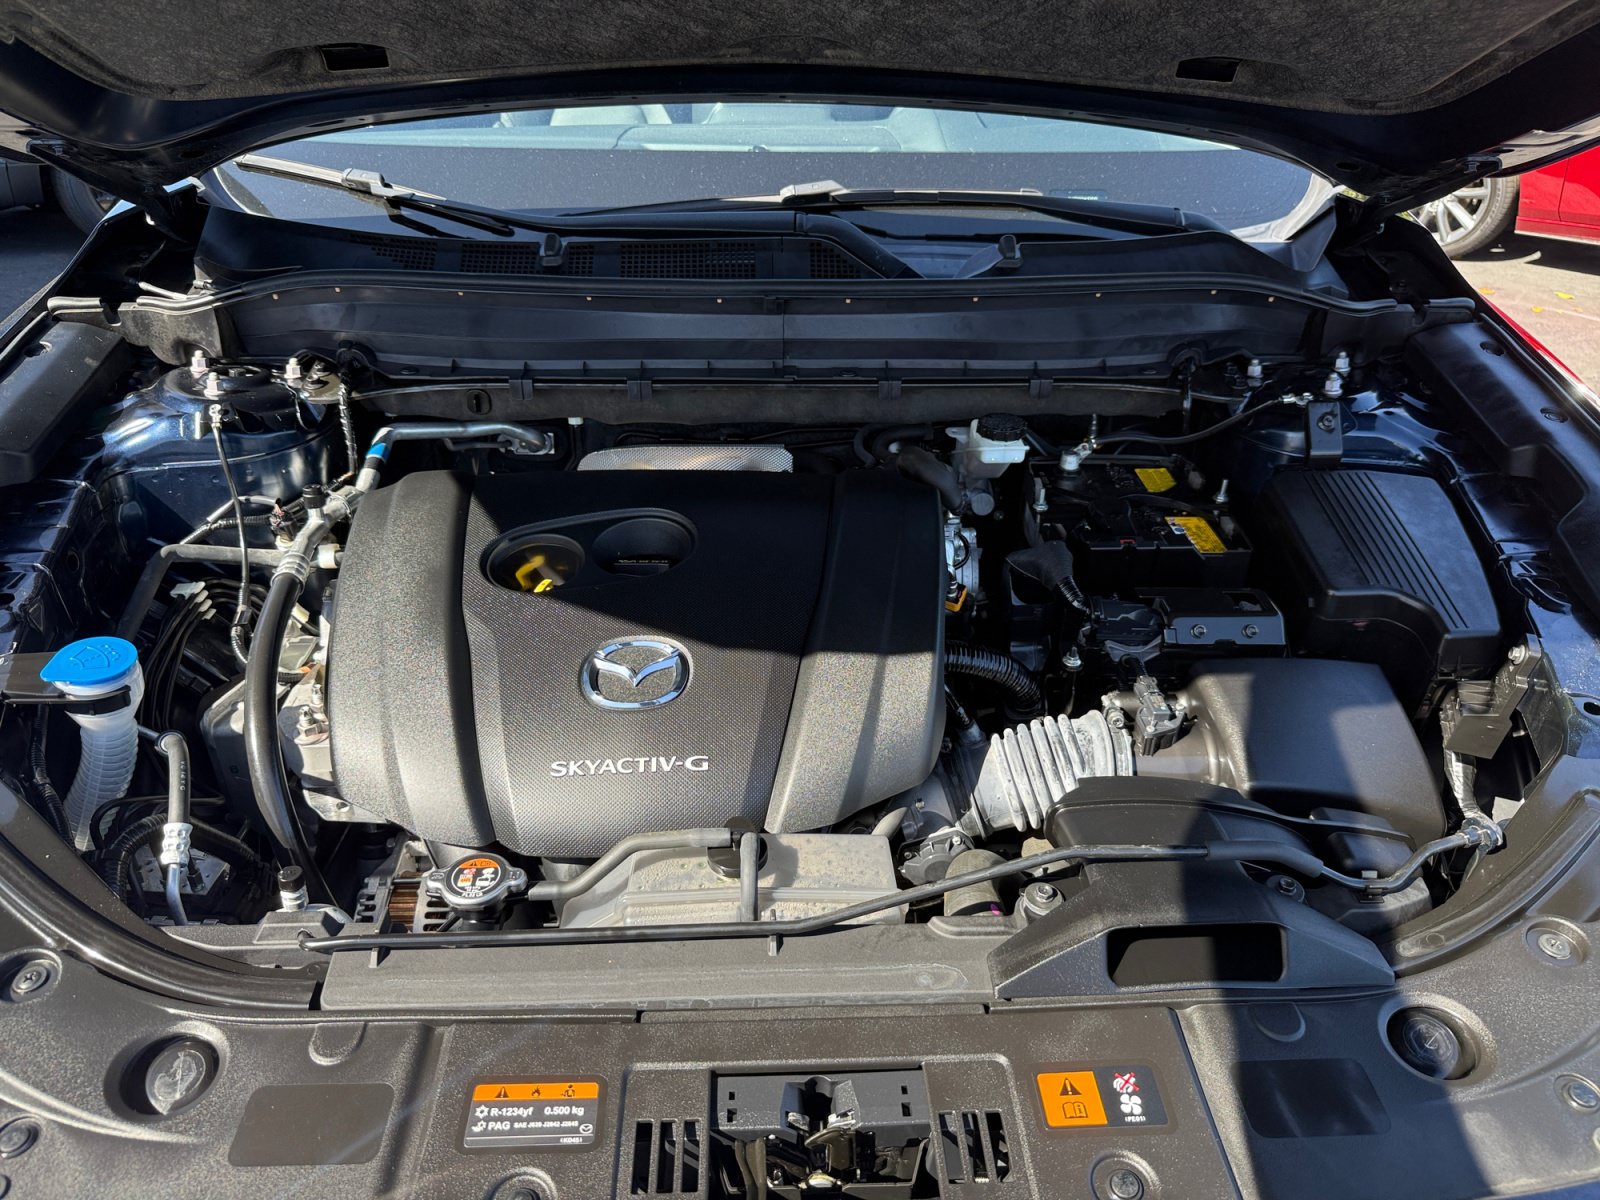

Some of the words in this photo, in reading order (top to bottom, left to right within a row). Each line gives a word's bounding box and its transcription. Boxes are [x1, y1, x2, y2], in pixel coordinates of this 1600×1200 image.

[550, 755, 709, 777] SKYACTIV-G
[490, 1106, 534, 1118] R-1234yf
[544, 1106, 570, 1116] 0.500
[571, 1105, 585, 1117] kg
[487, 1121, 511, 1131] PAG
